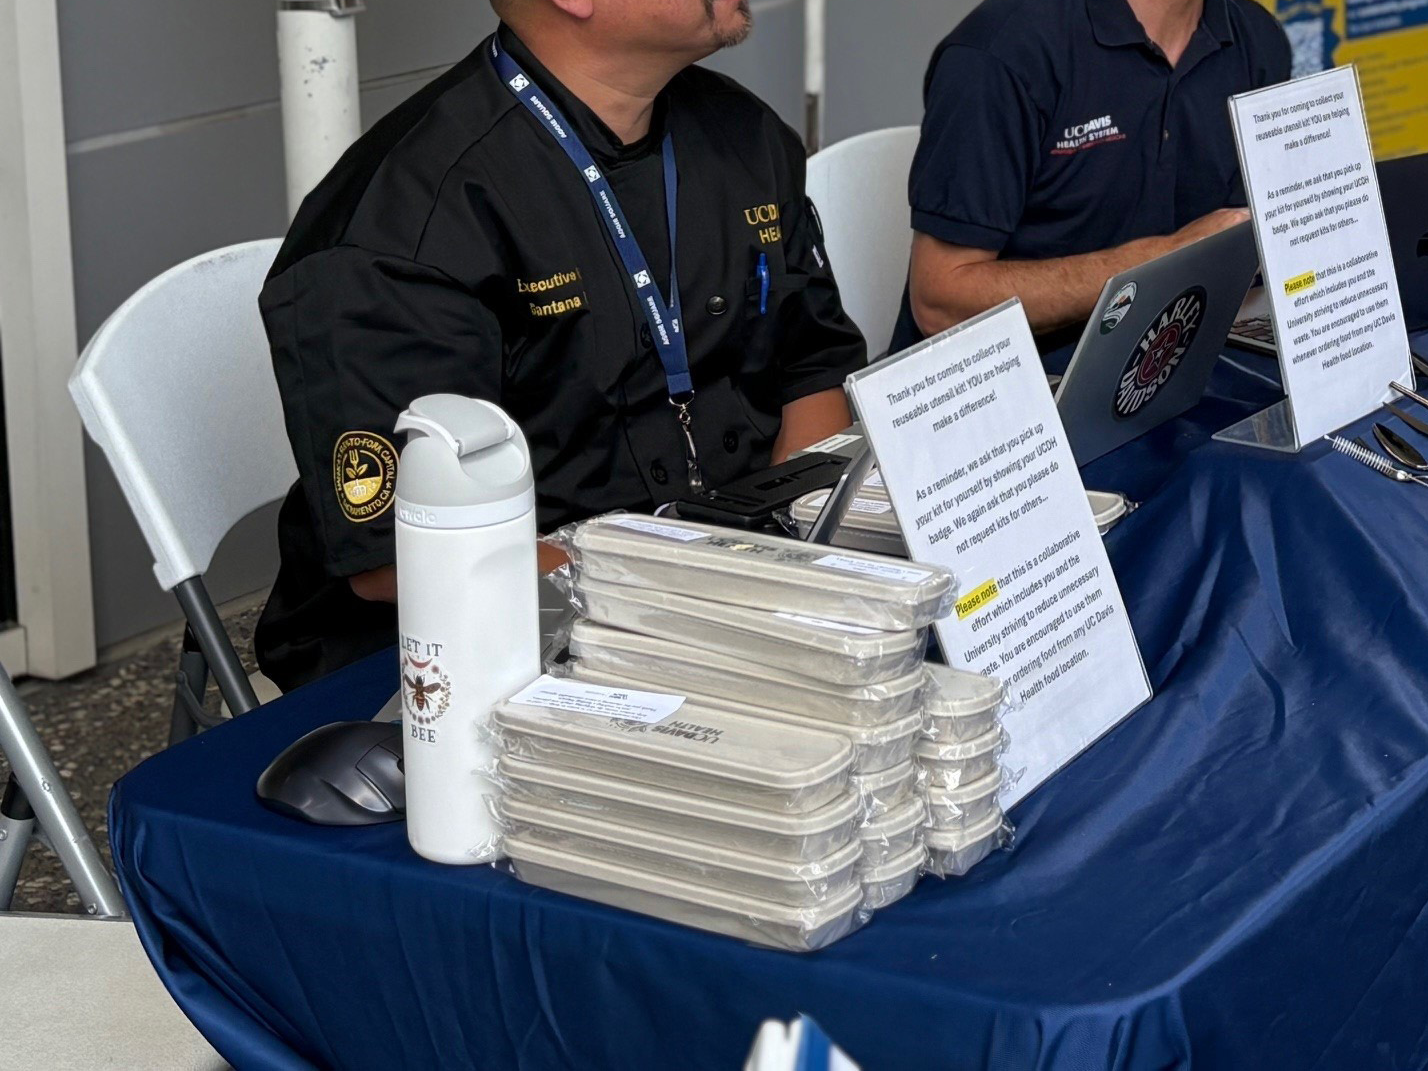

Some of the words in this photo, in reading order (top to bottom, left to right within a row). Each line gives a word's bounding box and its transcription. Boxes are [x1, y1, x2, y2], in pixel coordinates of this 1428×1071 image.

[886, 386, 911, 405] Thank
[911, 380, 925, 397] you
[925, 375, 936, 387] for
[937, 361, 965, 381] coming
[963, 358, 971, 367] to
[971, 344, 996, 363] collect
[995, 338, 1010, 354] your
[892, 403, 929, 428] reuseable
[929, 388, 955, 409] utensil
[954, 381, 967, 395] kit!
[966, 373, 983, 389] YOU
[983, 370, 995, 381] are
[994, 355, 1021, 375] helping
[933, 415, 953, 432] make
[953, 412, 959, 421] a
[959, 389, 997, 418] difference!
[955, 595, 981, 617] Please
[981, 584, 997, 600] note
[997, 573, 1012, 589] that
[1012, 565, 1026, 580] this
[1026, 561, 1033, 571] is
[1033, 558, 1038, 566] a
[1038, 530, 1080, 563] collaborative
[972, 612, 992, 632] effort
[992, 598, 1014, 618] which
[1012, 580, 1043, 604] includes
[1042, 571, 1055, 587] you
[1055, 560, 1069, 576] and
[1068, 555, 1080, 567] the
[401, 632, 420, 654] LET
[426, 642, 442, 657] IT
[964, 633, 1001, 663] University
[1001, 614, 1028, 638] striving
[1026, 610, 1035, 620] to
[1035, 594, 1058, 615] reduce
[1058, 566, 1099, 599] unnecessary
[1020, 680, 1044, 703] Health
[1044, 666, 1060, 685] food
[1059, 650, 1089, 674] location.
[411, 724, 436, 743] BEE
